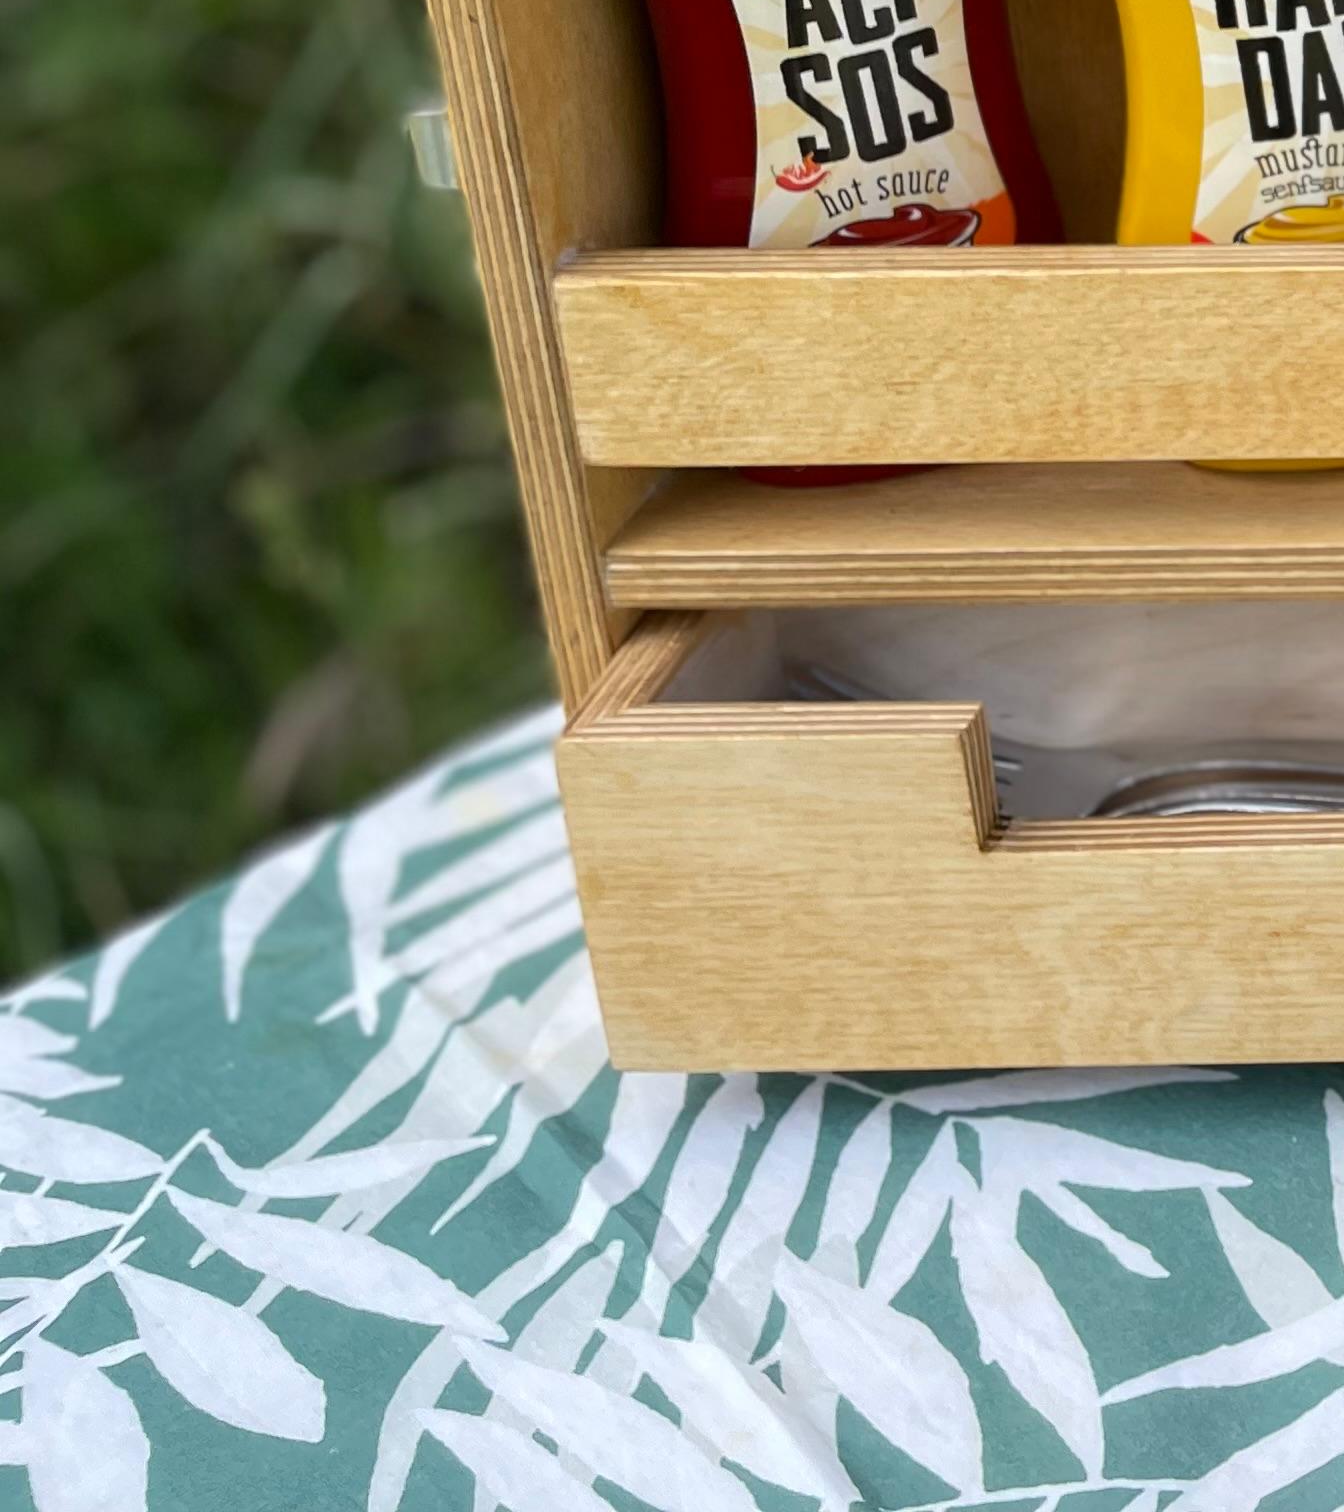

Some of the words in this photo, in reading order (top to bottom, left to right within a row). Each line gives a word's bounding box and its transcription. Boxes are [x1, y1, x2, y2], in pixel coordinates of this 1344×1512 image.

[779, 26, 955, 164] SOS
[814, 177, 869, 219] hot
[876, 167, 950, 202] sauce
